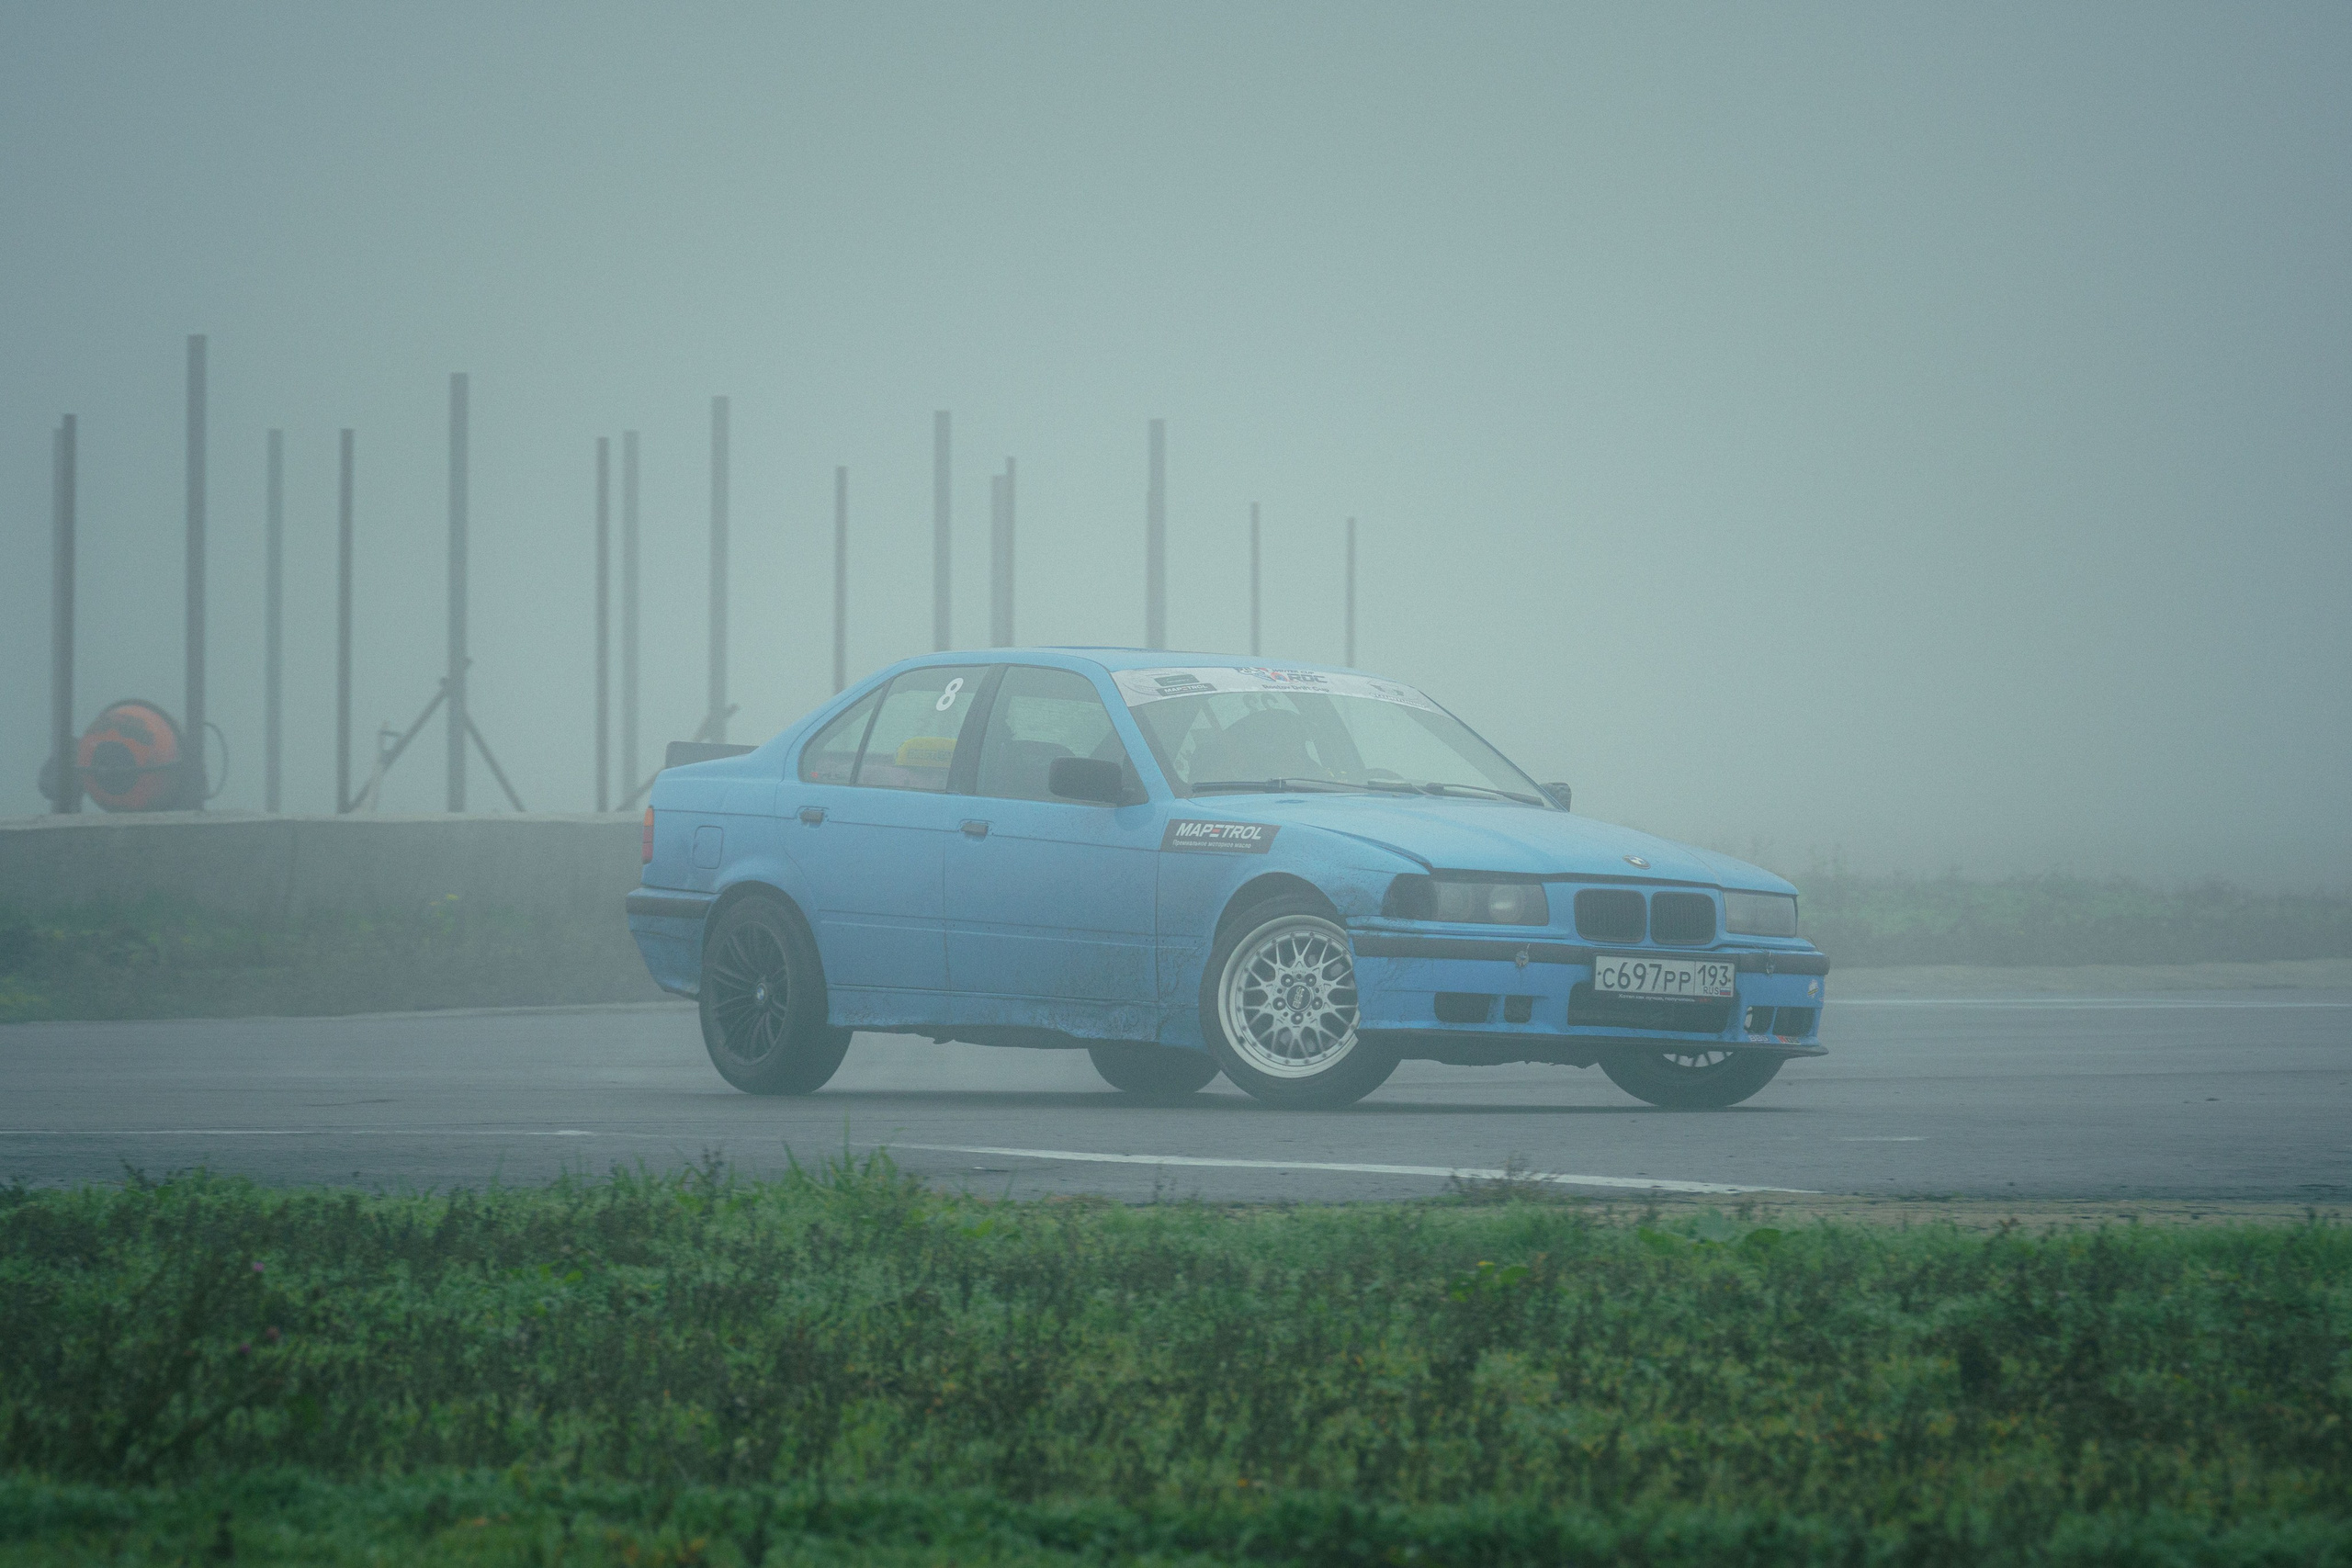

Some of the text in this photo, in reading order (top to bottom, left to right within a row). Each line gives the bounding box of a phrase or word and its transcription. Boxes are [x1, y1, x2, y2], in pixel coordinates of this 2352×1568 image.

[1287, 673, 1328, 683] RDC
[936, 677, 964, 711] 8
[1164, 684, 1208, 693] MAPETROL
[1176, 823, 1262, 840] MAPETROL
[1697, 964, 1729, 986] 193
[1703, 987, 1719, 995] RUS
